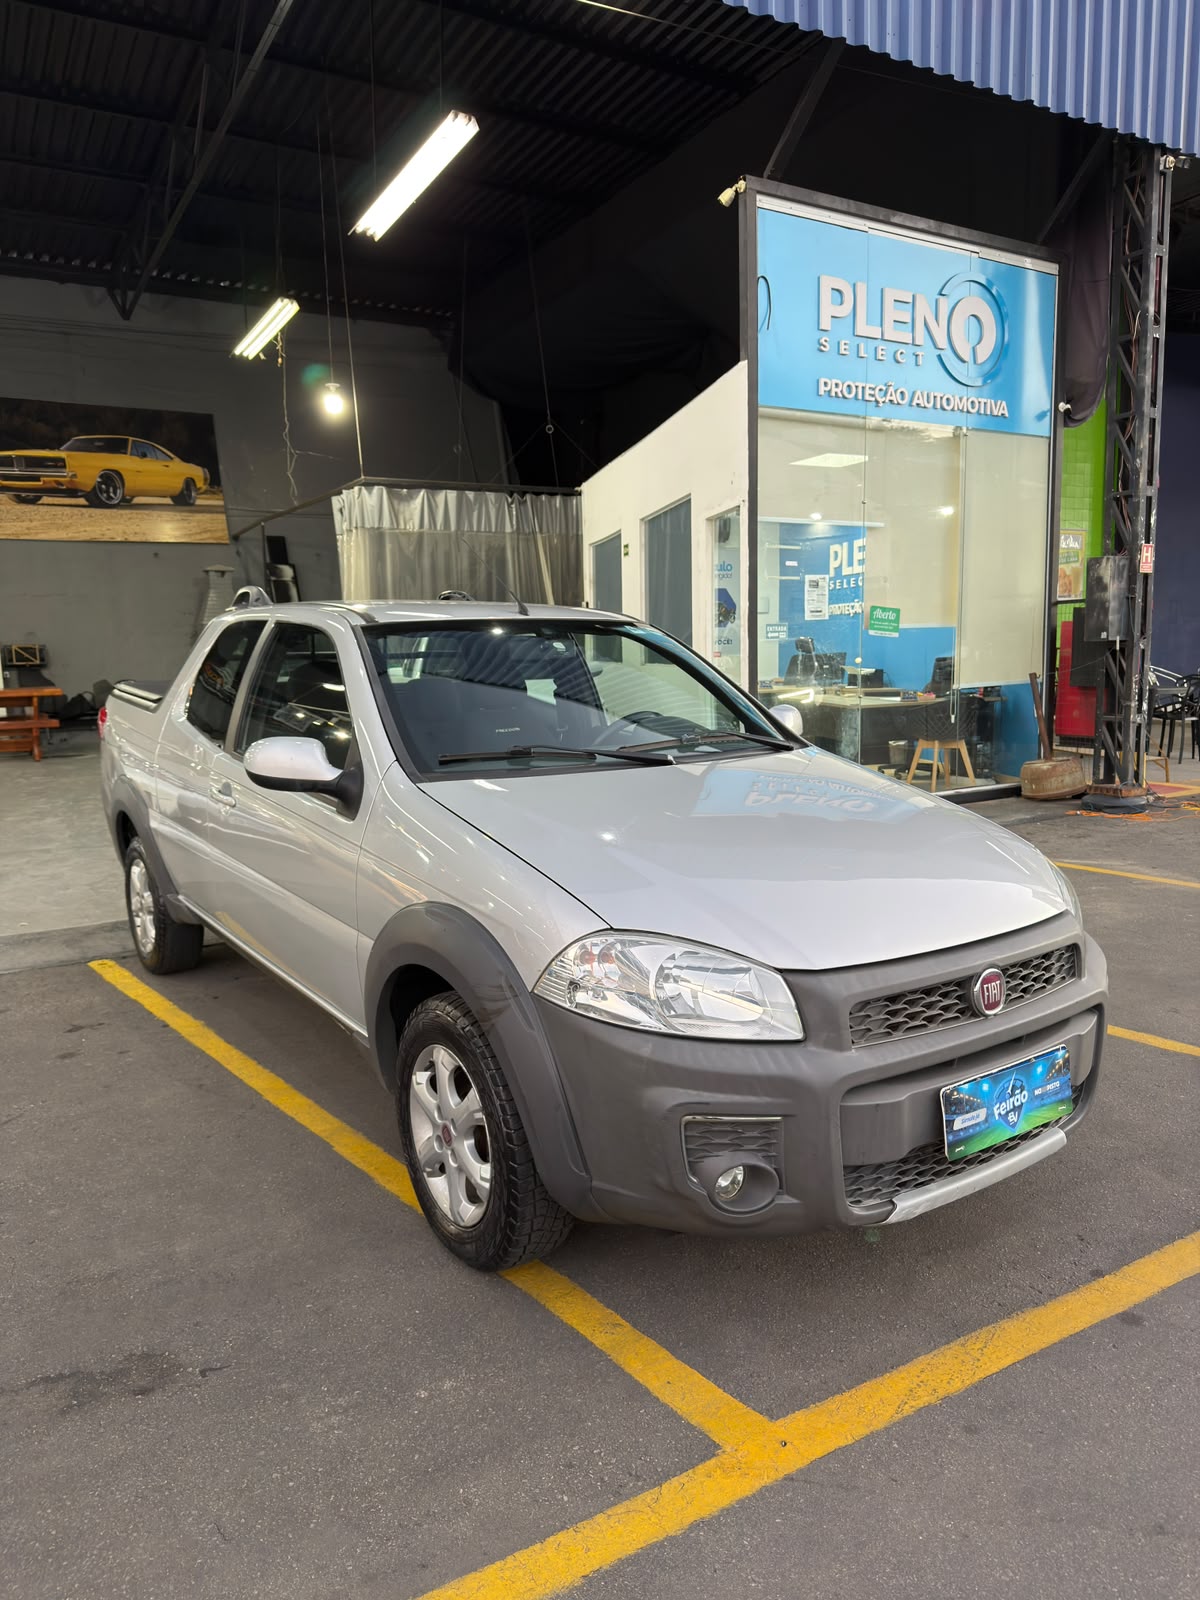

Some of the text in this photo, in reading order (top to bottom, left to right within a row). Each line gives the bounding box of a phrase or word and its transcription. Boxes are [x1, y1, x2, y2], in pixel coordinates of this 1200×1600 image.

[818, 274, 997, 365] PLENO
[818, 336, 925, 366] SELECT
[818, 377, 1009, 418] PROTEÇÃO AUTOMOTIVA
[716, 560, 733, 572] ulo
[873, 607, 897, 620] Aberto
[983, 980, 1002, 1005] FIAT
[993, 1086, 1028, 1121] Feirão
